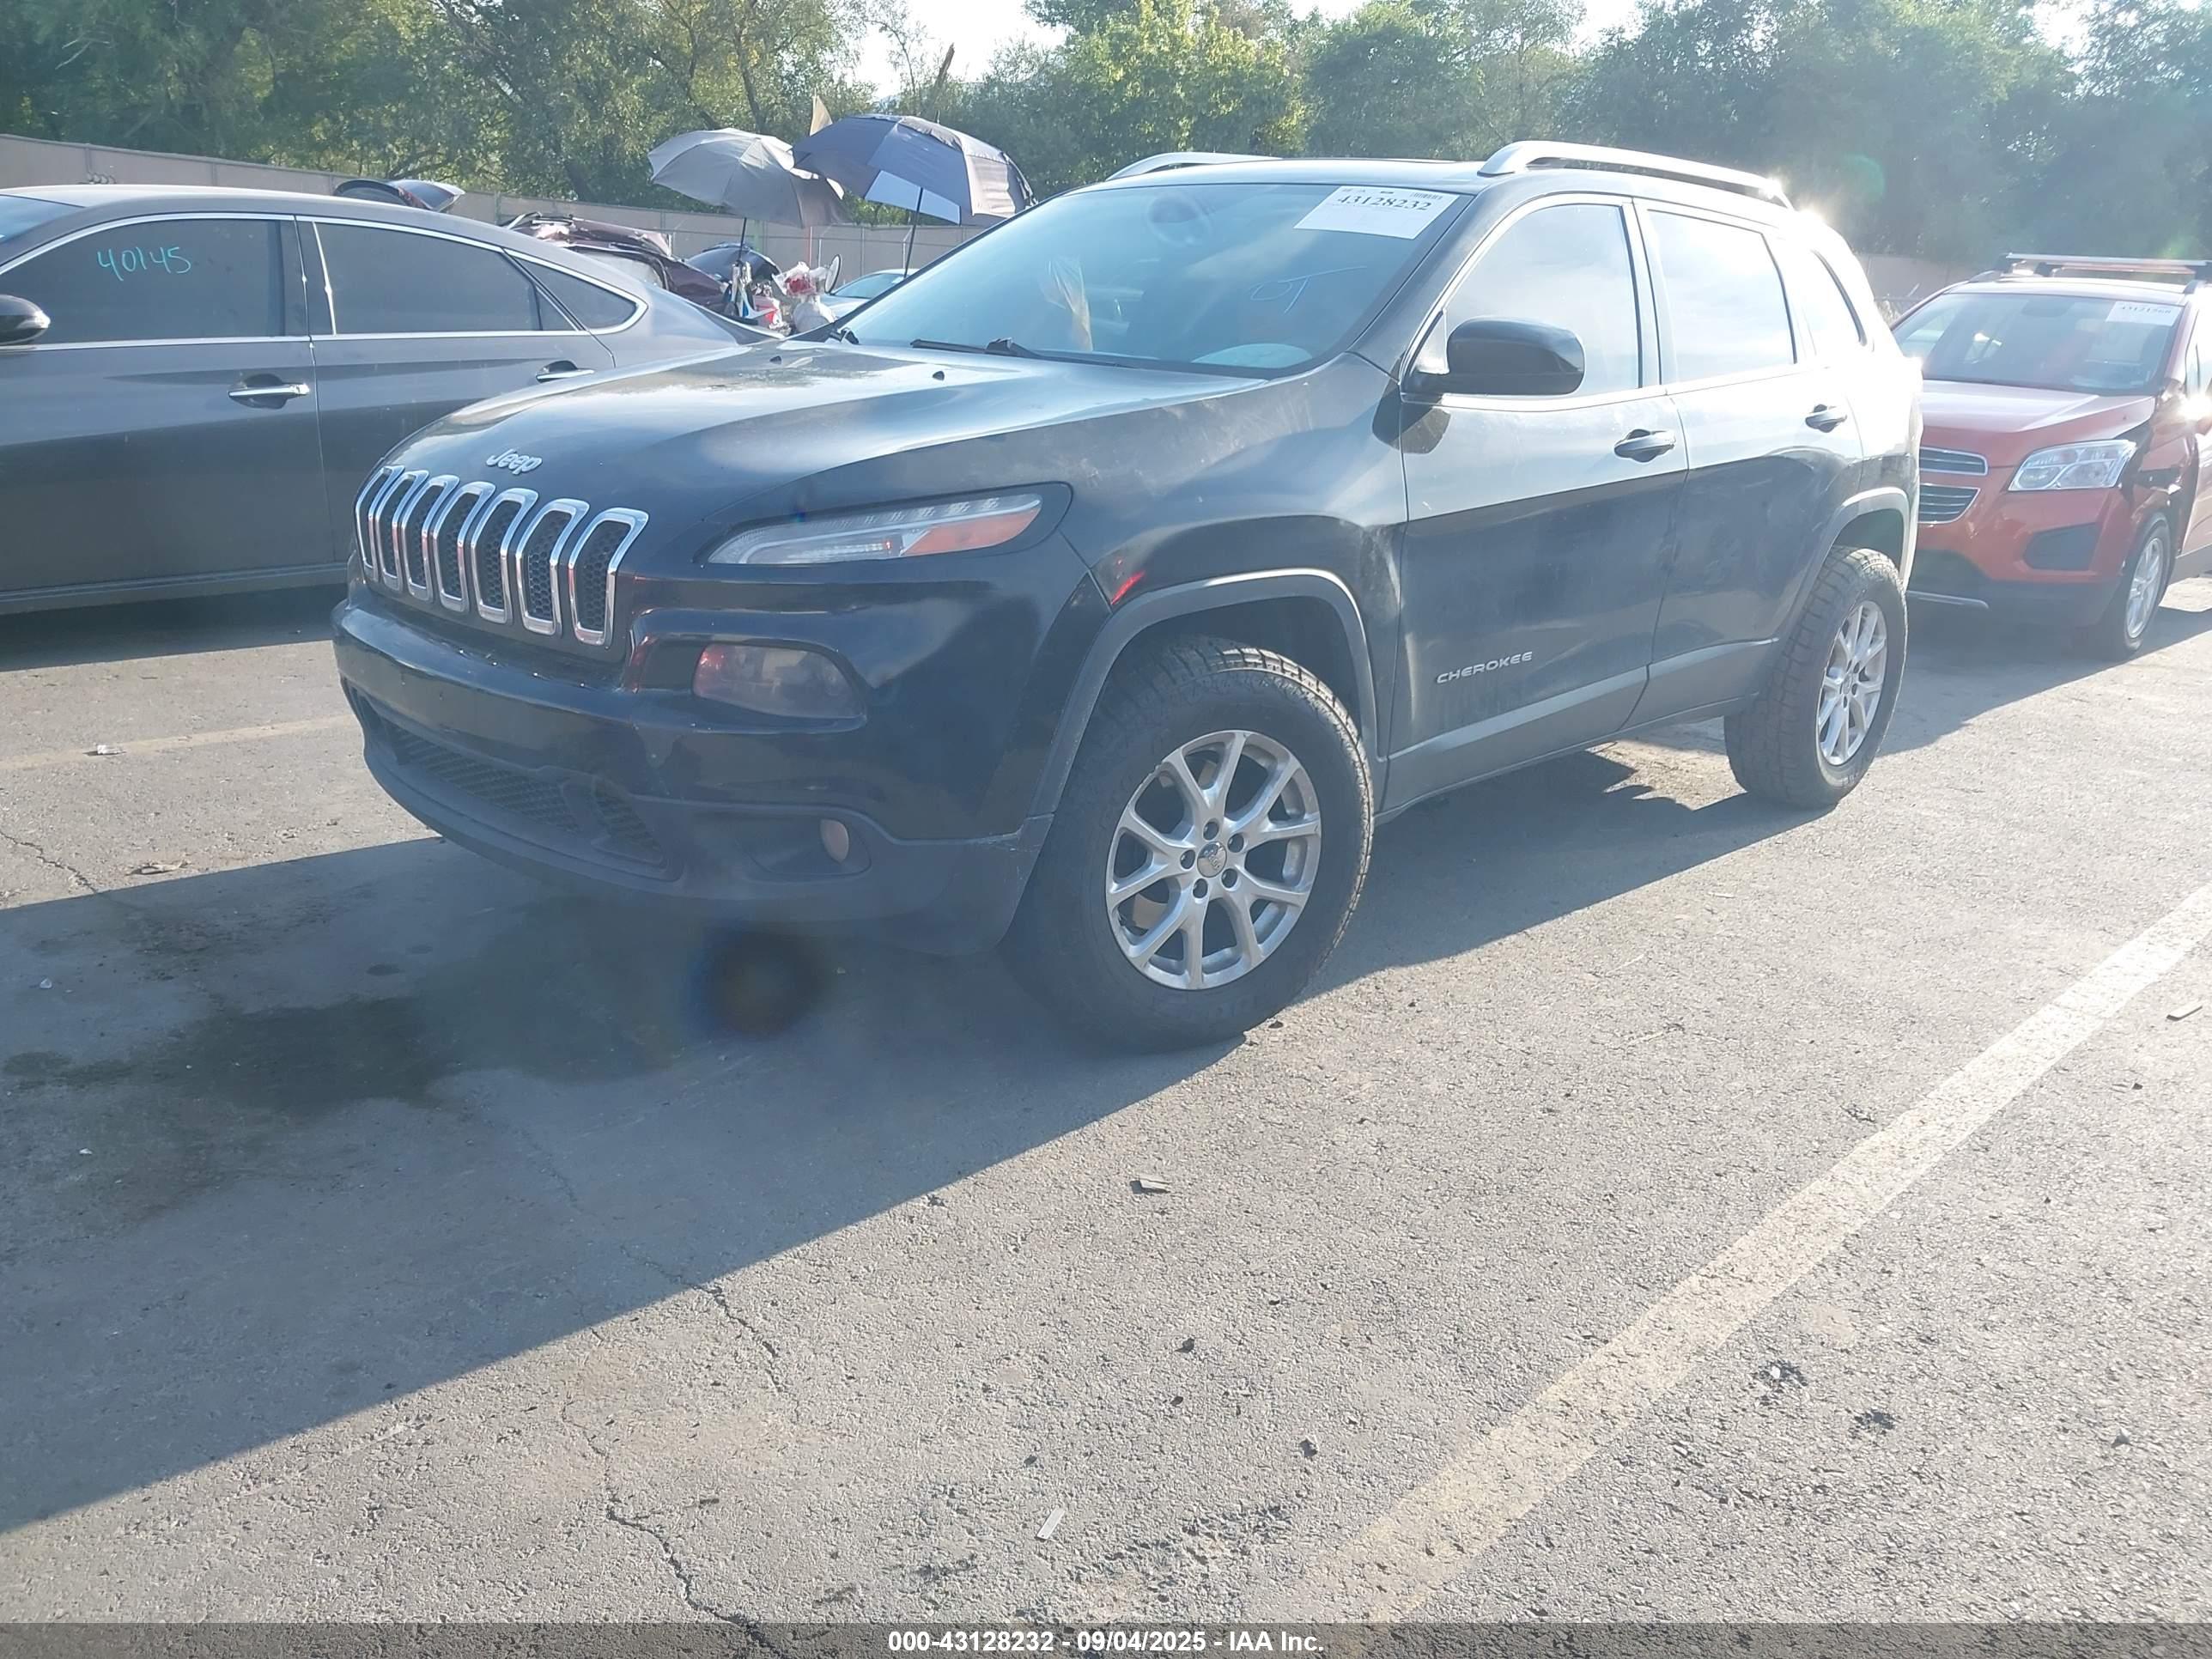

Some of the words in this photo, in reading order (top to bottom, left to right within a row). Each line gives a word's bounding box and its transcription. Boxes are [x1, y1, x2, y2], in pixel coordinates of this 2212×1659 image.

[1337, 194, 1432, 212] 43128232
[97, 246, 191, 282] 40145
[486, 448, 543, 475] Jeep
[1436, 651, 1534, 684] CHEROKEE
